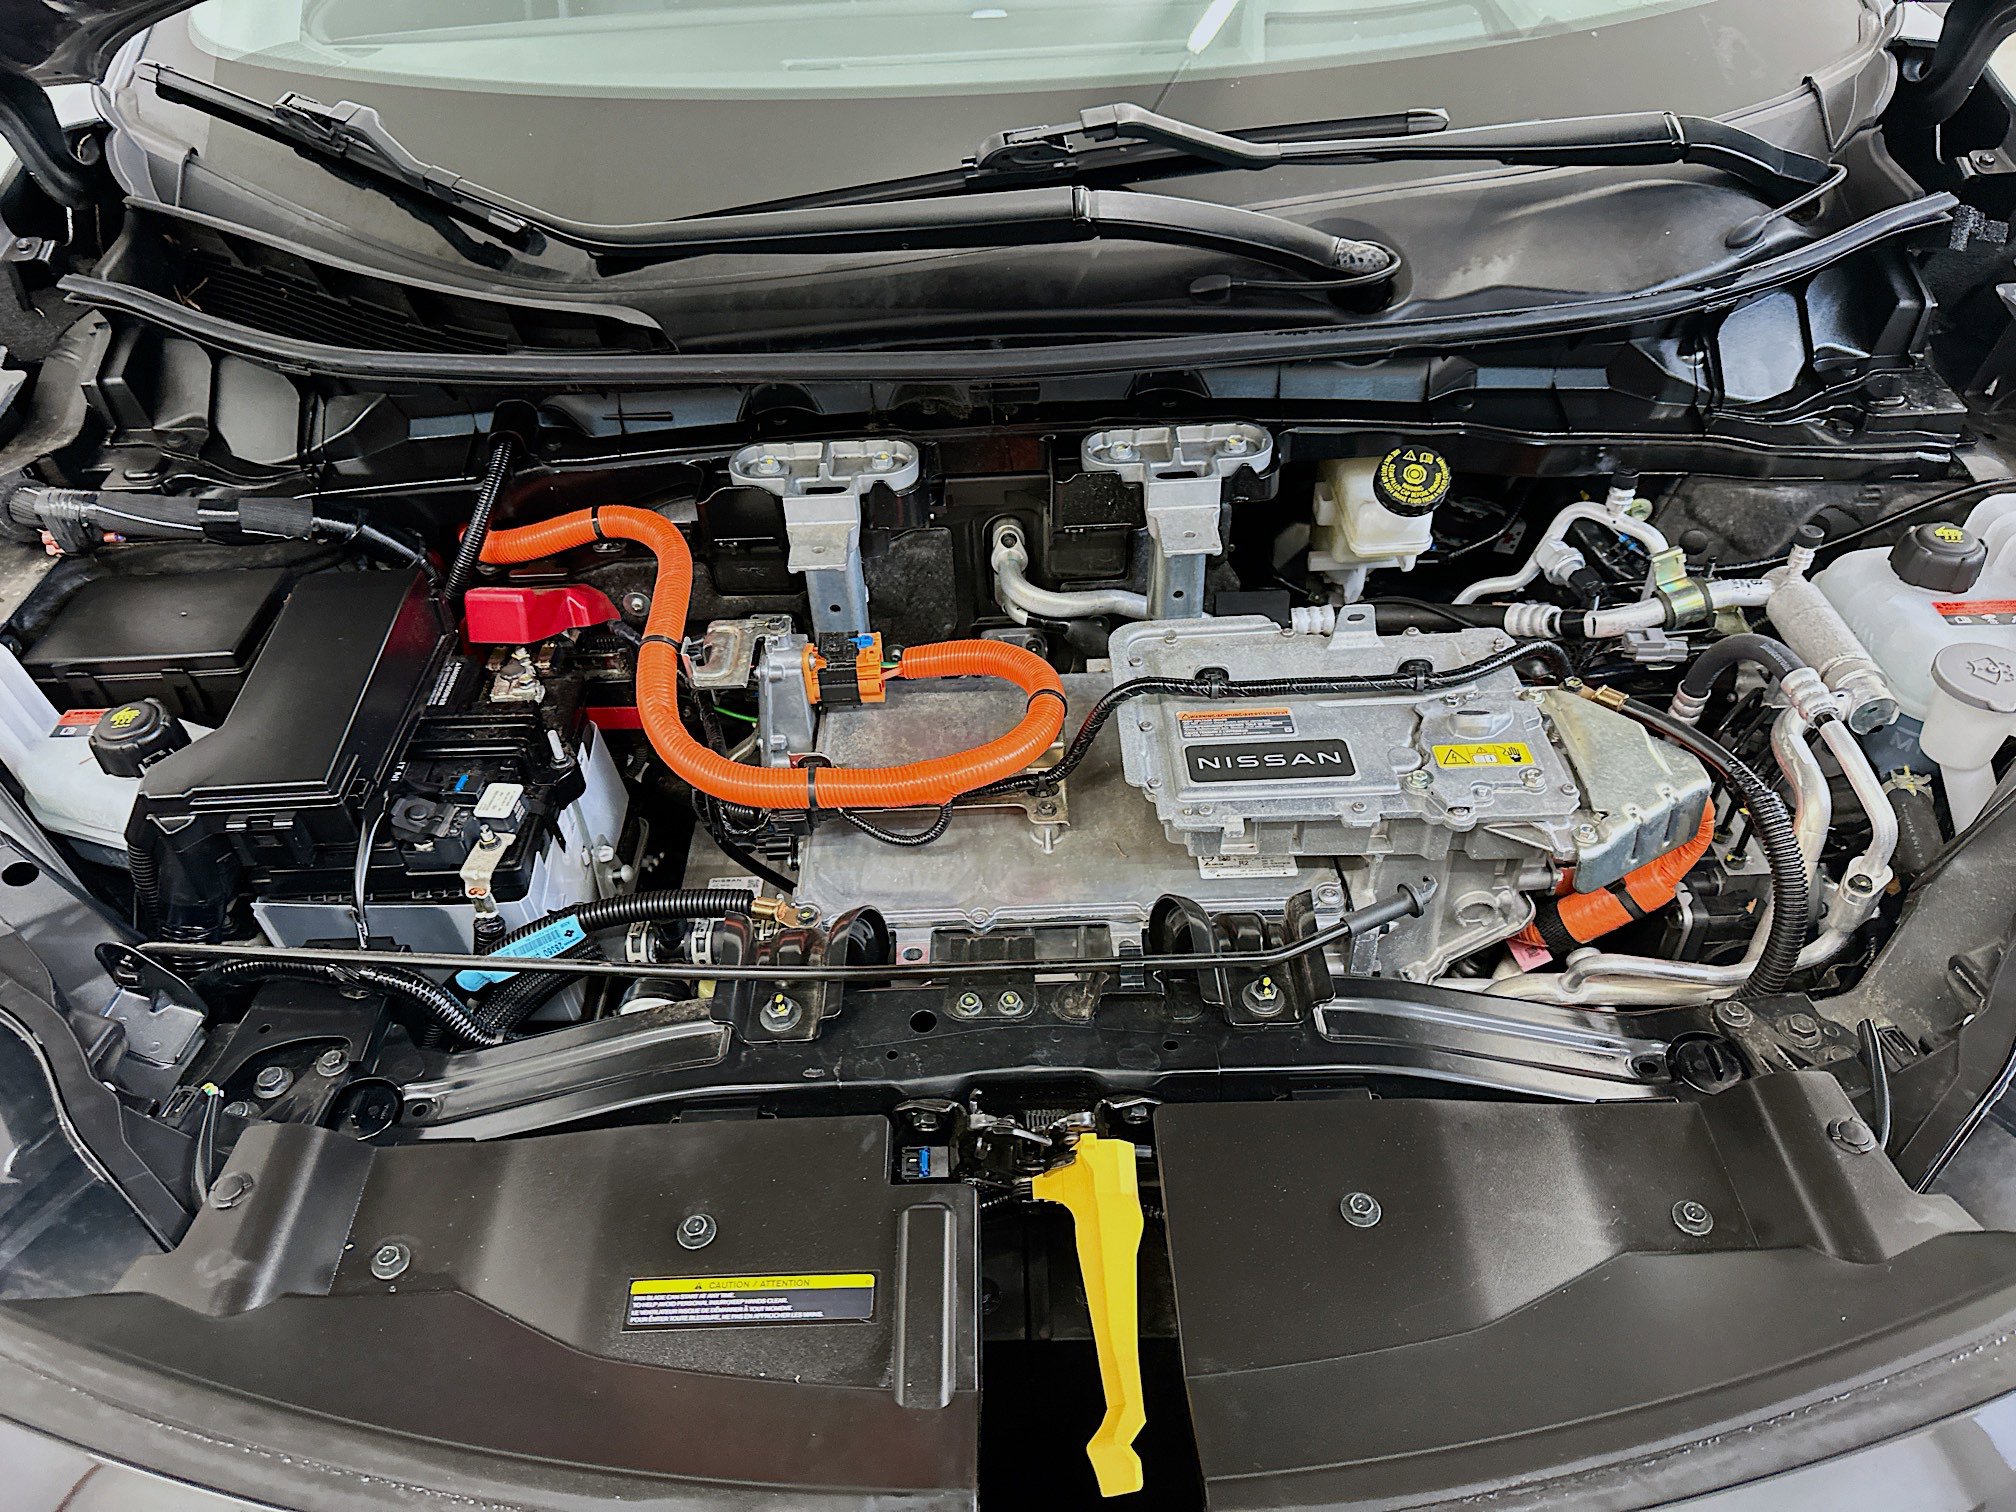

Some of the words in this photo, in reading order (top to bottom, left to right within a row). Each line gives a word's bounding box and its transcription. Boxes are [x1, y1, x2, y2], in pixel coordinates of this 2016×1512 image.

[1400, 488, 1411, 496] CAP
[1410, 489, 1430, 498] BEFORE
[1197, 751, 1342, 770] NISSAN
[709, 1281, 750, 1289] CAUTION
[760, 1279, 811, 1288] ATTENTION
